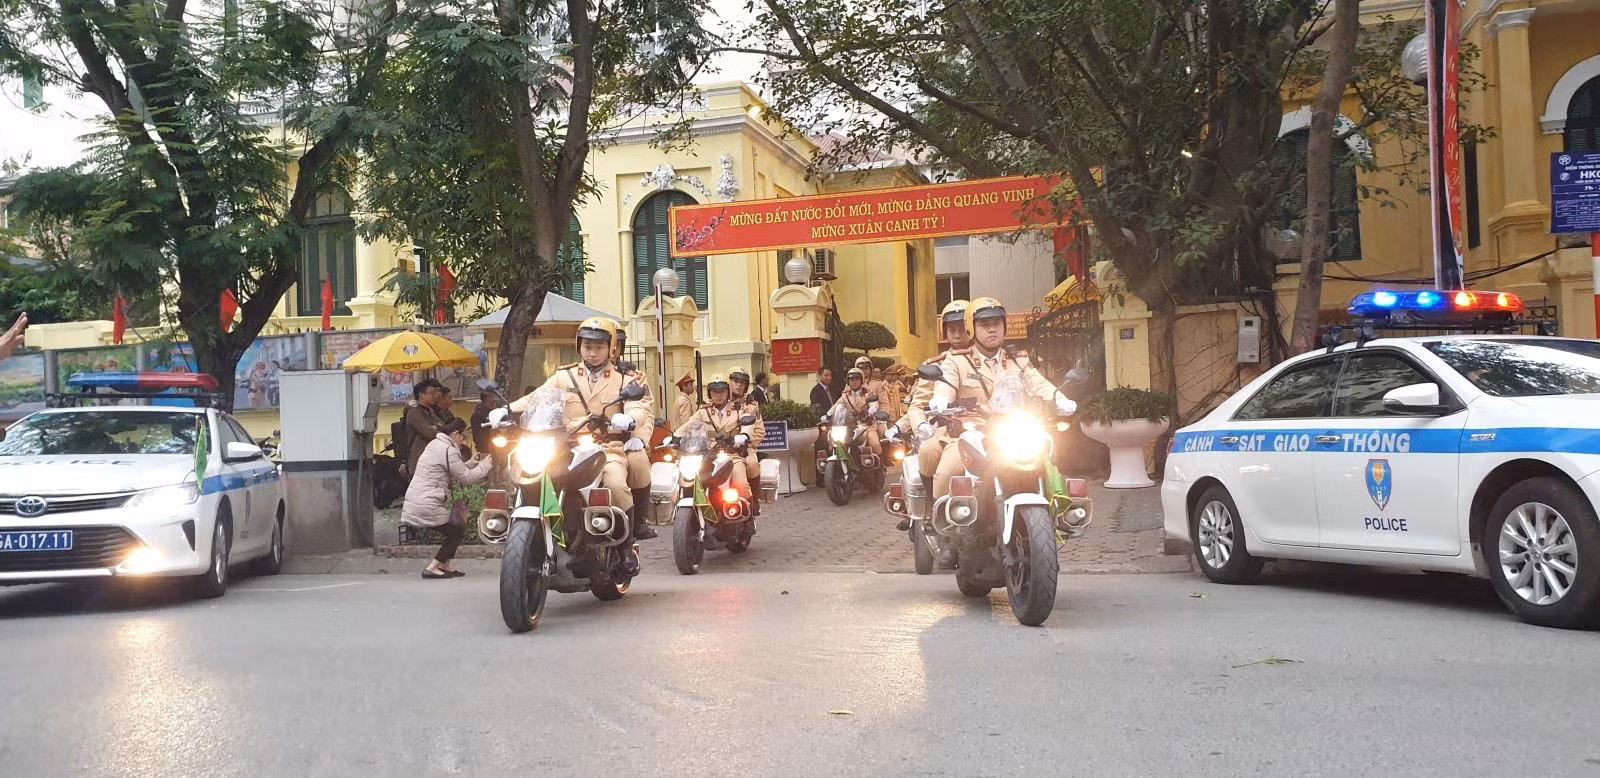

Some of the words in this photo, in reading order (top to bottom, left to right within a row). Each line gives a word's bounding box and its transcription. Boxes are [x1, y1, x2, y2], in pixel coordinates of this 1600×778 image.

[730, 211, 763, 227] MỪNG
[765, 206, 788, 224] ĐẤT
[791, 204, 822, 221] NƯỚC
[825, 199, 846, 219] ĐỔI
[849, 202, 875, 218] MỚI,
[878, 199, 913, 215] MỪNG
[916, 192, 951, 211] ĐẢNG
[954, 191, 1000, 208] QUANG
[1002, 188, 1035, 201] VINH
[811, 223, 846, 239] MỪNG
[849, 219, 883, 236] XUÂN
[886, 218, 920, 233] CANH
[923, 213, 939, 229] TÝ
[402, 361, 422, 369] CSGT
[1239, 431, 1265, 451] SÁT
[1274, 433, 1310, 452] GIAO
[1342, 430, 1411, 452] THÔNG
[1364, 517, 1408, 532] POLICE
